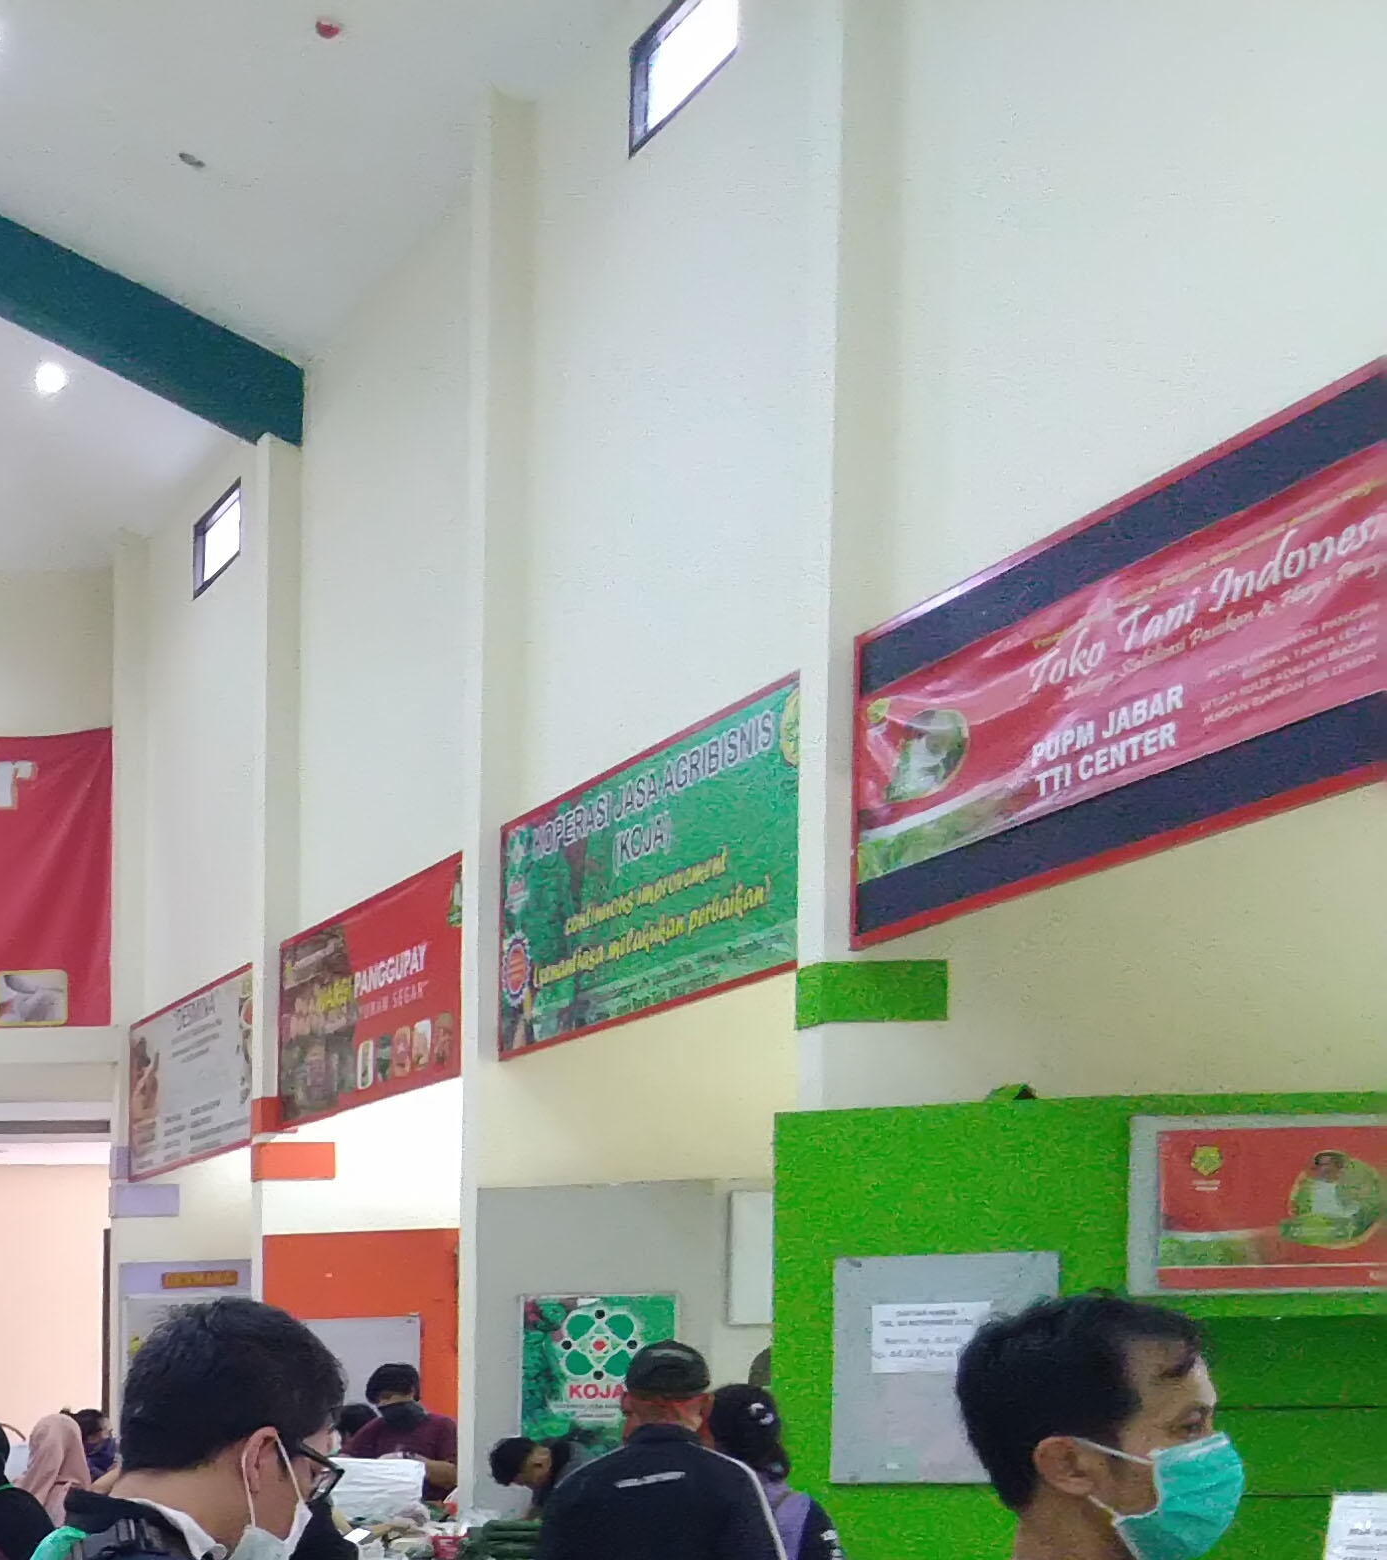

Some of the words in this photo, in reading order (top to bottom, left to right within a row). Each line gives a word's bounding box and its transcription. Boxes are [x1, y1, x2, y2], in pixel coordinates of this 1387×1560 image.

[1030, 627, 1107, 693] Toko
[1117, 587, 1203, 652] Tani
[615, 770, 659, 822] JASA
[662, 710, 775, 796] AGRIBISNIS
[1031, 720, 1096, 768] PUPM
[1102, 684, 1185, 739] JABAR
[1035, 762, 1073, 797] TTI
[1078, 721, 1177, 781] CENTER
[568, 1383, 625, 1399] KOJA
